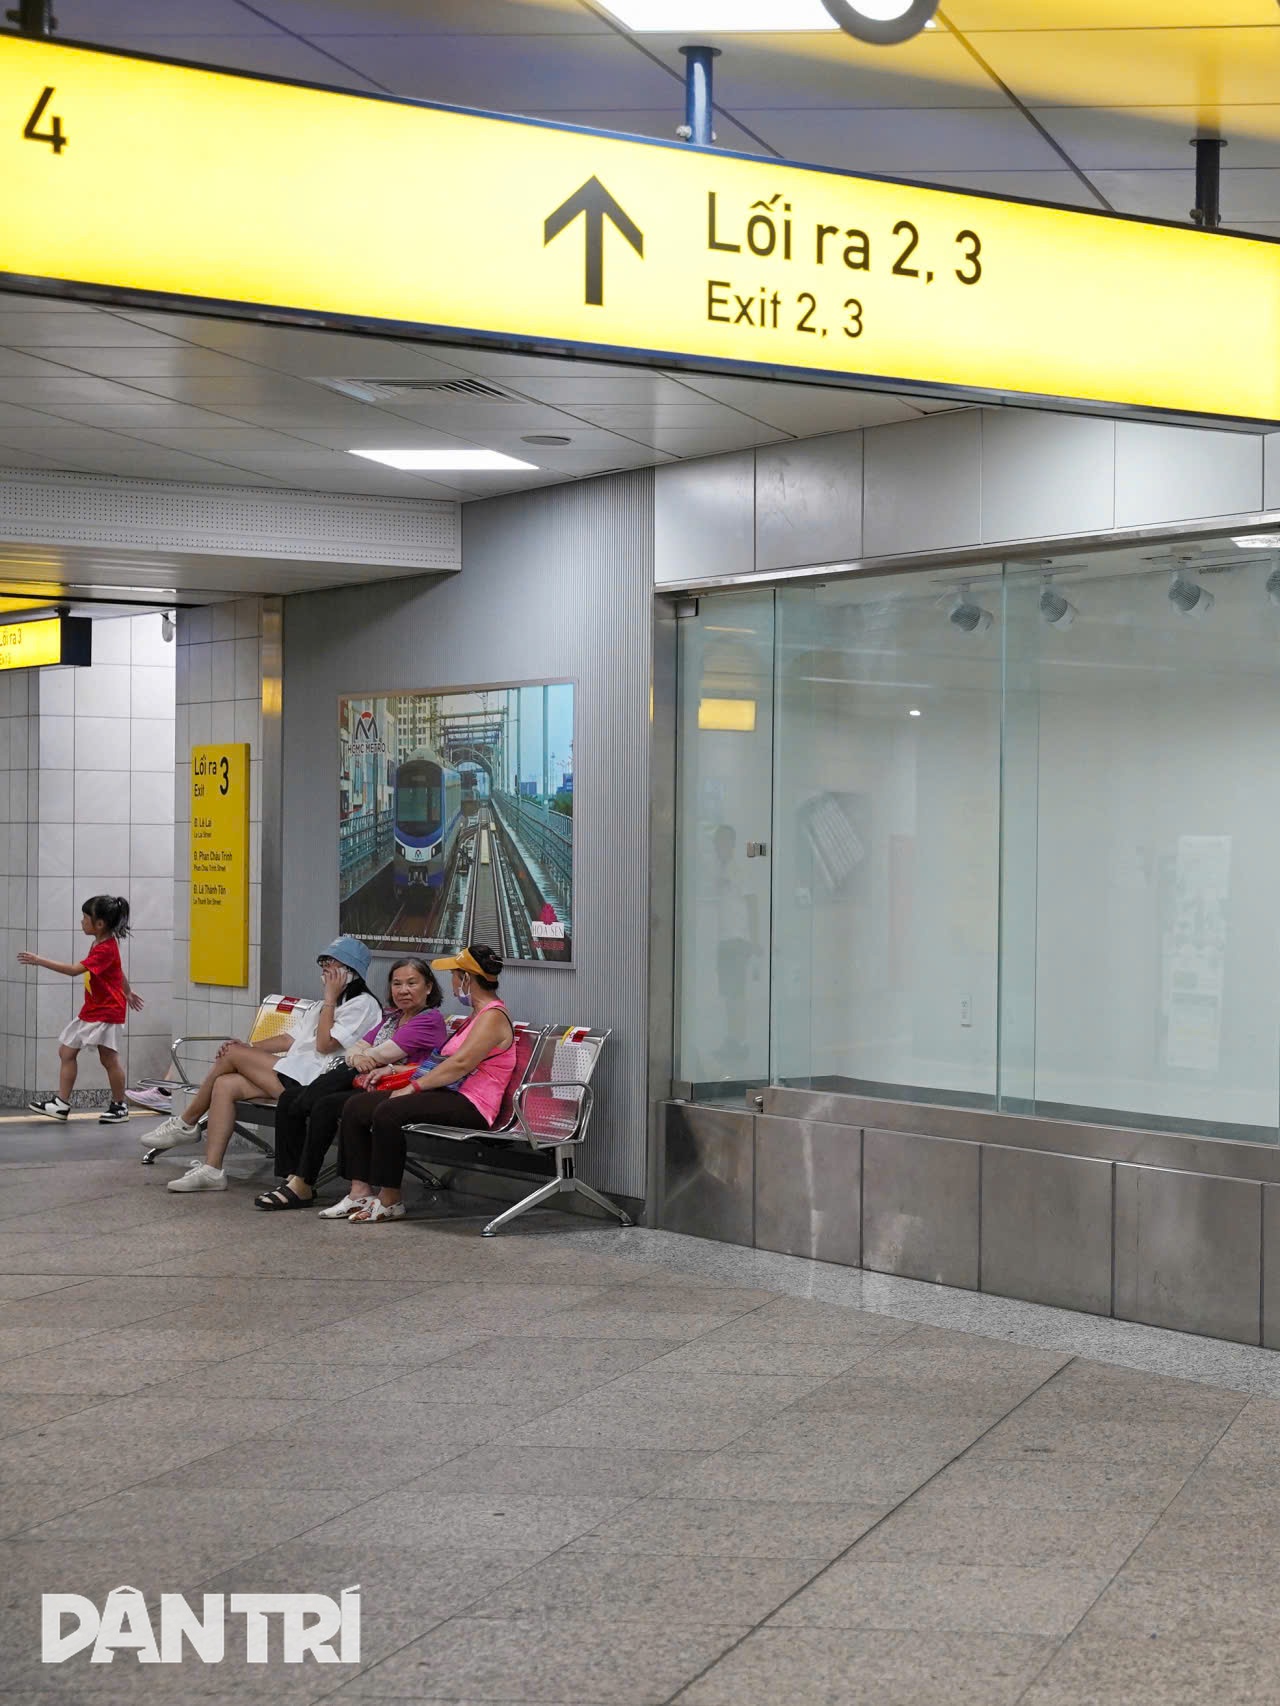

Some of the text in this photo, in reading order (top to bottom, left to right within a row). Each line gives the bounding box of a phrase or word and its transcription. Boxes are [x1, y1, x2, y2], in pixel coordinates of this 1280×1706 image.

[24, 86, 67, 154] 4
[708, 191, 793, 260] Lối
[816, 224, 870, 272] ra
[955, 229, 982, 285] 3
[708, 280, 781, 328] Exit
[843, 298, 863, 338] 3
[348, 742, 386, 754] HCMC METRO
[194, 754, 229, 796] Lối ra 3
[194, 783, 205, 797] Exit
[532, 924, 549, 937] HOA
